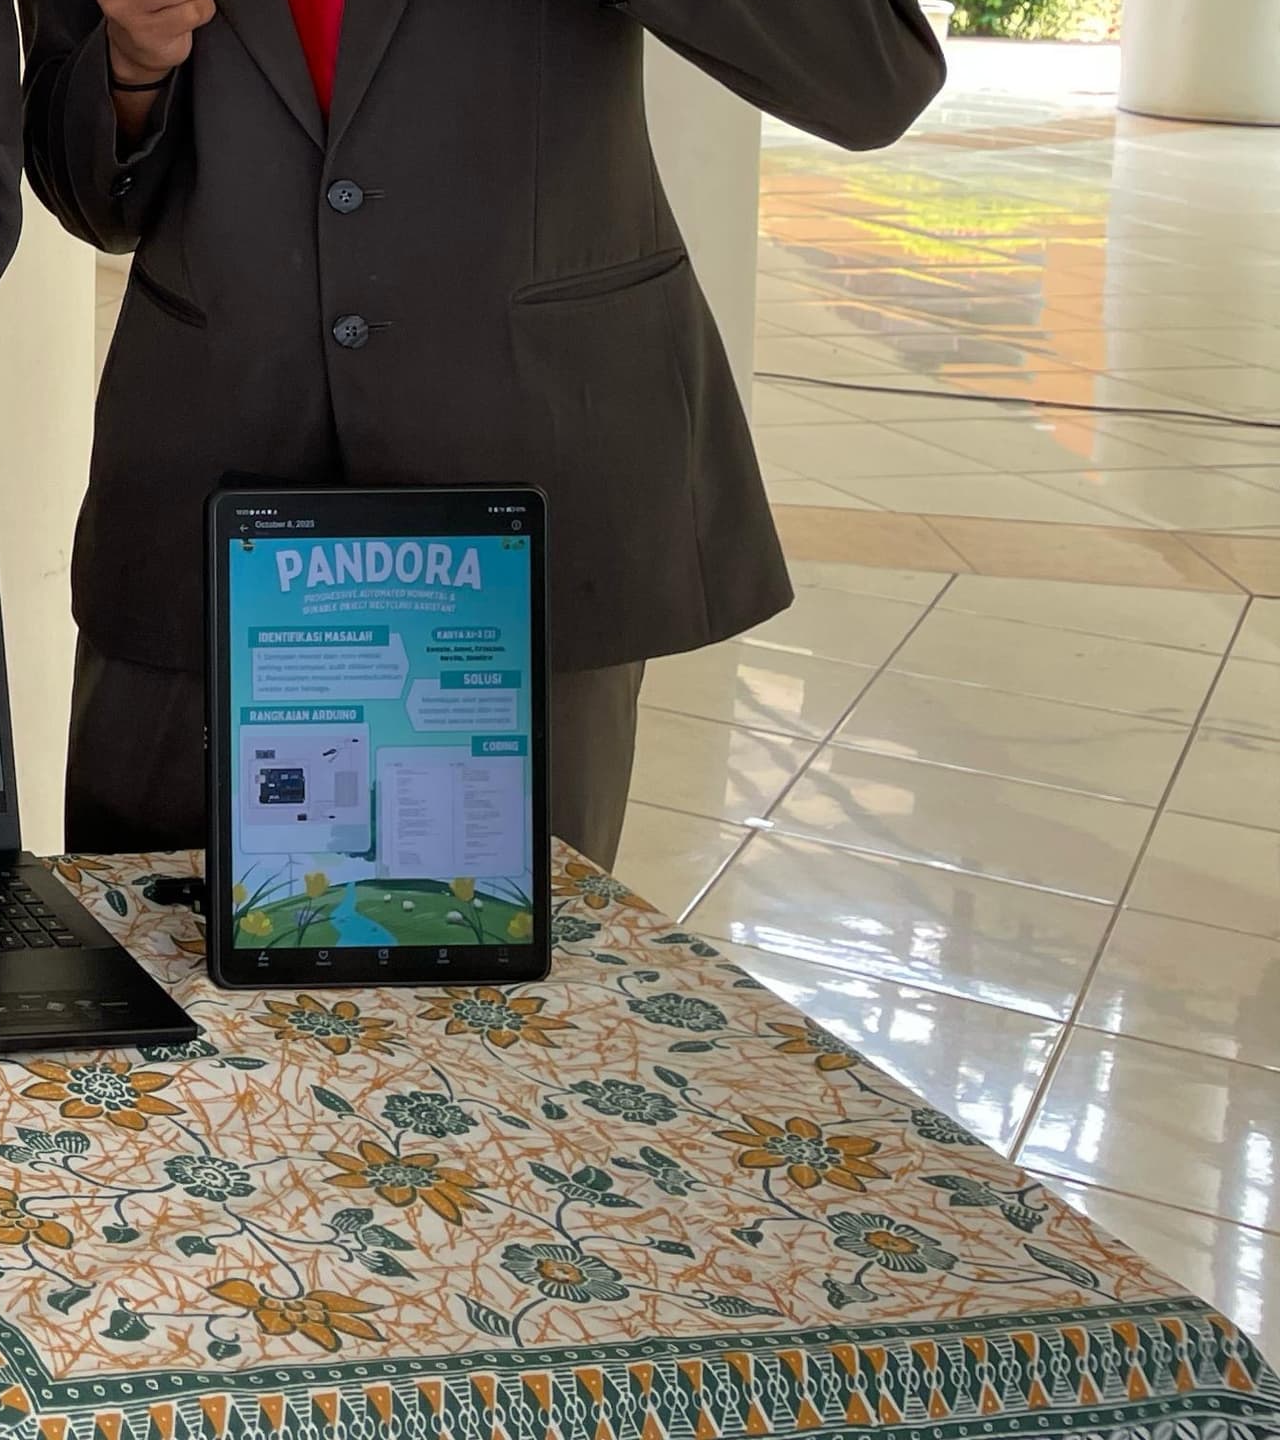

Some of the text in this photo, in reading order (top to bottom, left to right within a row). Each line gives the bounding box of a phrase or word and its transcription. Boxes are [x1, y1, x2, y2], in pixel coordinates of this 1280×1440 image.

[275, 541, 482, 592] PANDORA
[324, 631, 373, 643] MASALAH
[463, 673, 502, 685] SOLUSI
[249, 710, 357, 722] RANGKAIAN ARDUINO
